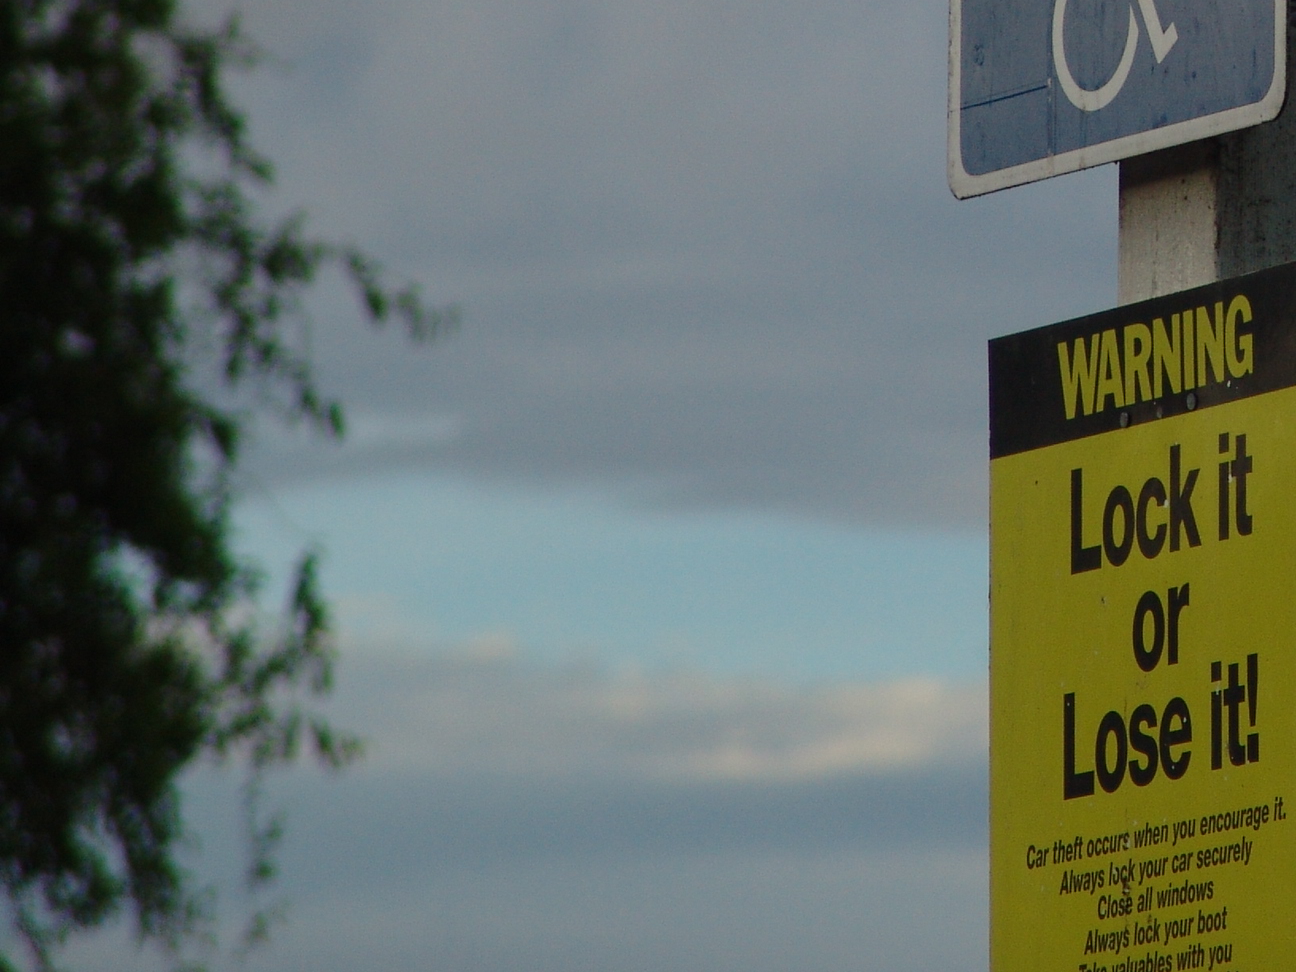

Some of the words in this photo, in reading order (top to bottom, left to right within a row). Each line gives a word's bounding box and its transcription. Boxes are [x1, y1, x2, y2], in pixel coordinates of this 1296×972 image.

[1058, 294, 1254, 421] WARNING
[1070, 443, 1202, 575] Lock
[1218, 432, 1253, 541] it
[1132, 582, 1190, 673] or
[1063, 692, 1193, 800] Lose
[1211, 653, 1259, 771] it!
[1026, 844, 1049, 870] Car
[1053, 835, 1083, 865] theft
[1086, 836, 1130, 859] occurs
[1134, 822, 1169, 850] when
[1172, 818, 1196, 844] you
[1200, 804, 1269, 836] encourage
[1273, 796, 1287, 822] it.
[1060, 870, 1105, 896] Always
[1108, 858, 1135, 886] lock
[1138, 854, 1169, 883] your
[1172, 849, 1193, 874] car
[1196, 836, 1253, 869] securely
[1084, 927, 1130, 956] Always
[1133, 917, 1161, 945] lock
[1164, 917, 1194, 946] your
[1197, 908, 1228, 934] boot
[1097, 892, 1133, 920] Close
[1137, 886, 1153, 911] all
[1157, 879, 1214, 910] windows
[1176, 943, 1205, 971] with
[1208, 943, 1233, 971] you
